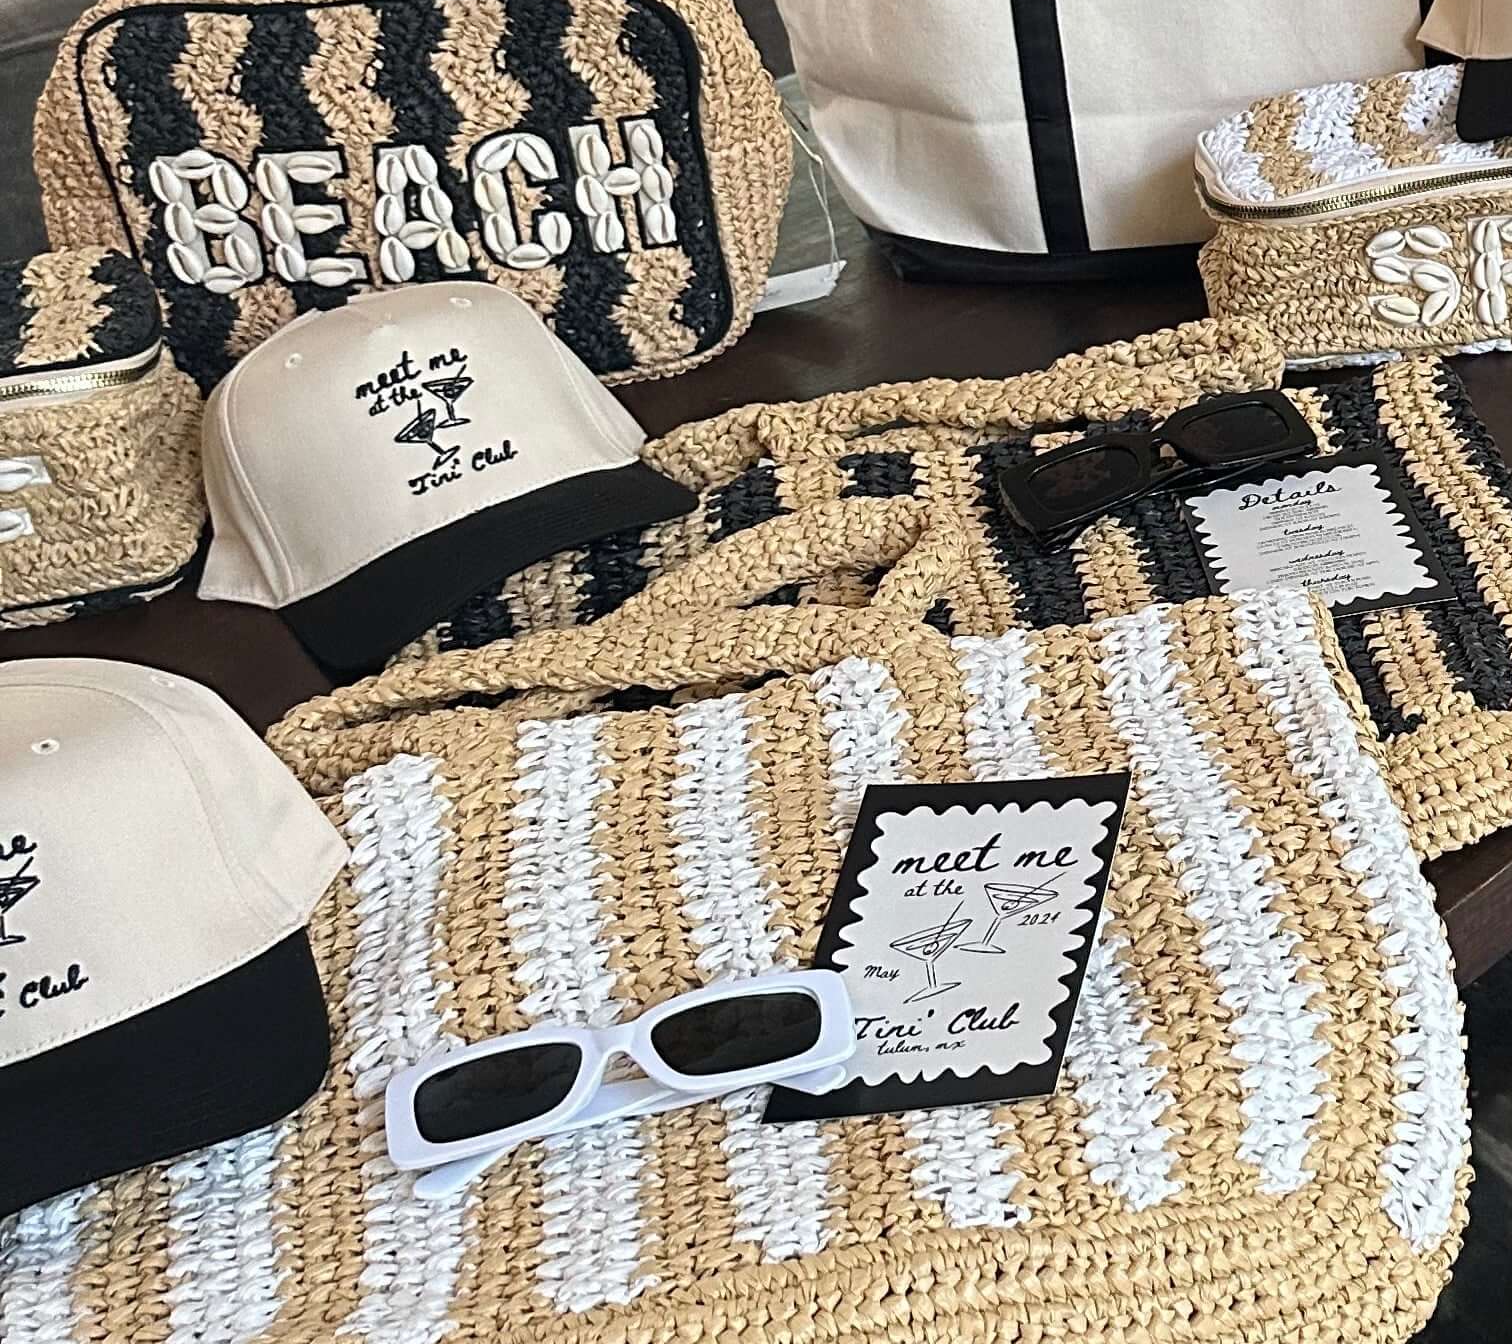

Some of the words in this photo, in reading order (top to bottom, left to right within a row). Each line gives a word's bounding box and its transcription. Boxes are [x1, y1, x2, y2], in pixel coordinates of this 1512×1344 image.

[149, 116, 678, 294] BEACH
[355, 350, 422, 400] meet
[429, 348, 468, 371] me
[368, 395, 390, 417] at
[388, 386, 422, 406] the
[471, 440, 518, 471] Club
[1238, 481, 1342, 510] Details
[891, 833, 1001, 875] meet
[1013, 846, 1078, 869] me
[904, 881, 927, 898] at
[934, 879, 965, 896] the
[19, 964, 89, 1008] Club
[864, 965, 900, 981] May
[947, 1002, 1020, 1035] Club
